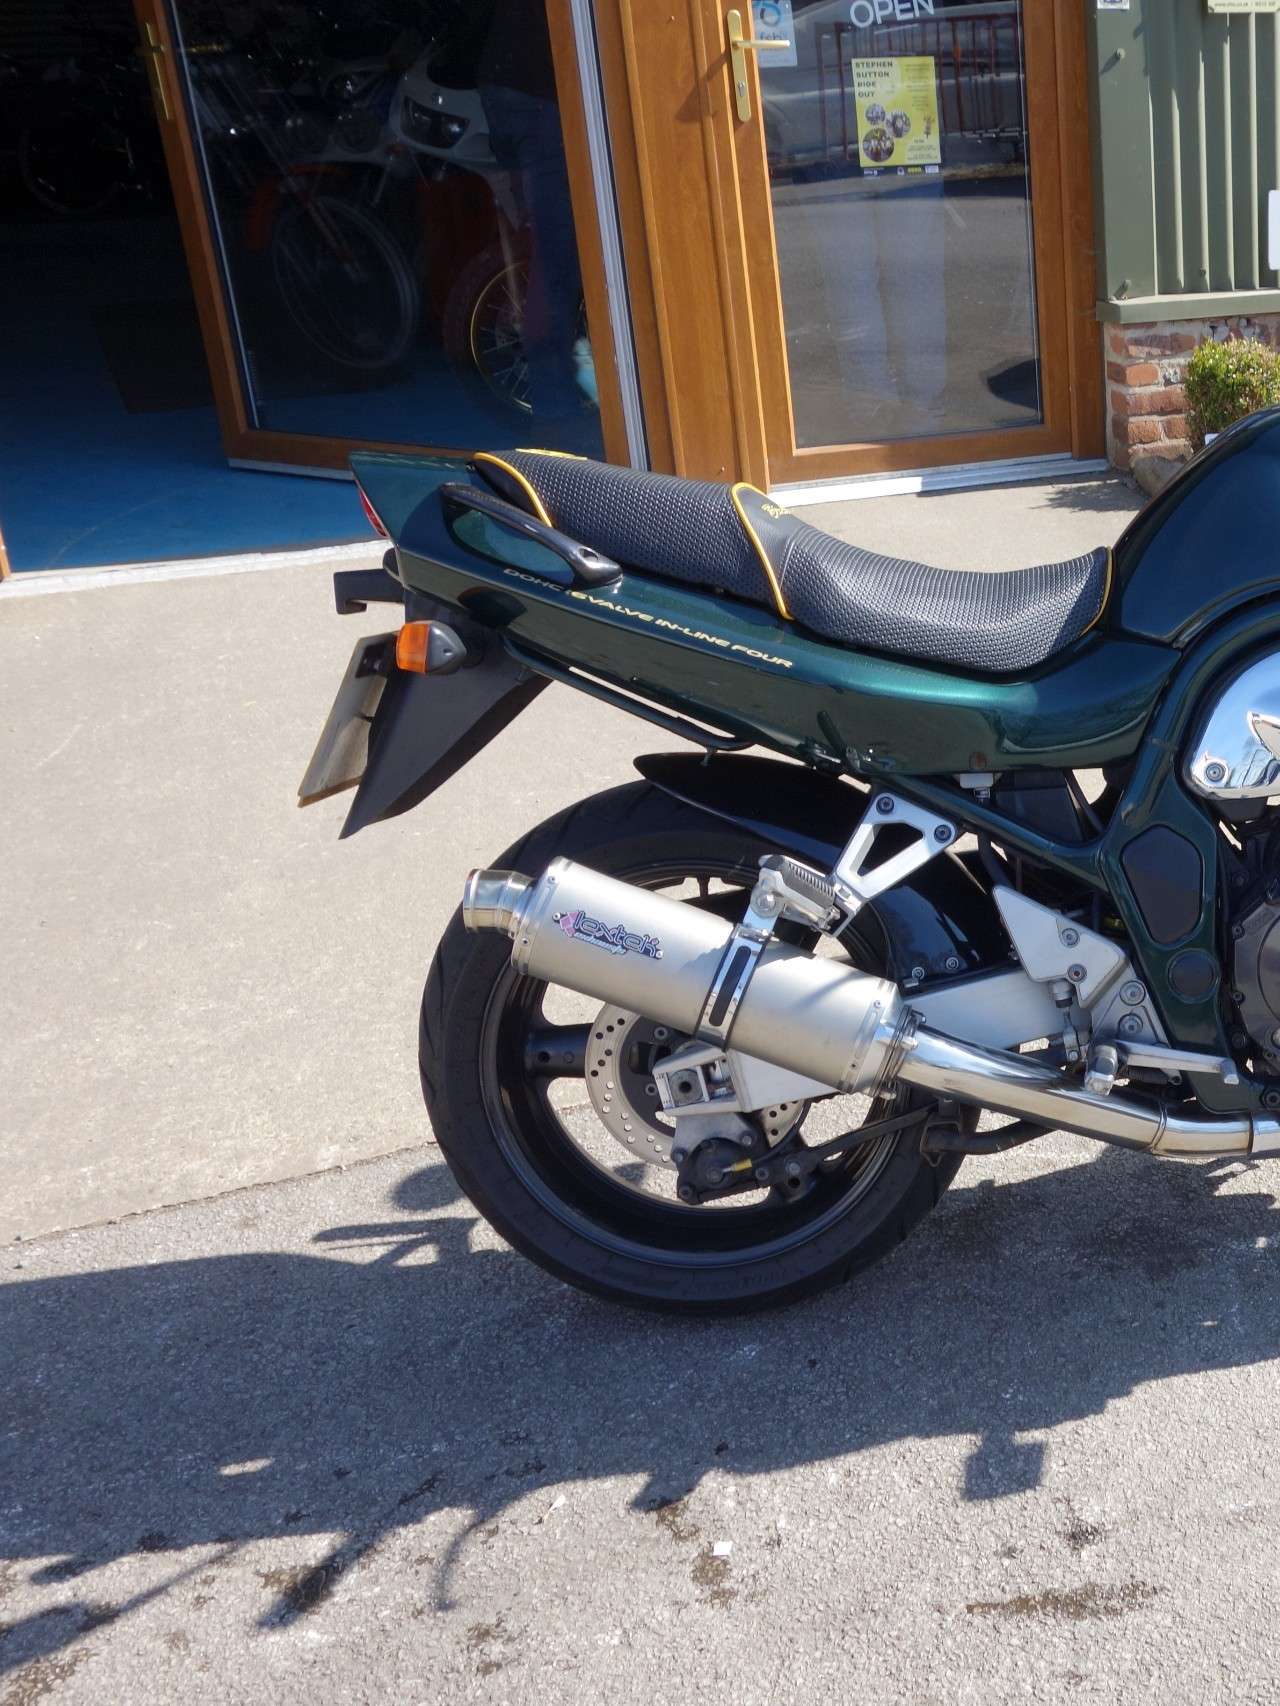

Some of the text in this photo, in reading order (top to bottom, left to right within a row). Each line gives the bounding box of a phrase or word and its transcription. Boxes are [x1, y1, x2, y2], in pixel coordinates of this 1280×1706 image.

[850, 0, 934, 28] OPEN
[503, 568, 565, 592] DOHC
[654, 618, 731, 648] IN-LINE
[731, 644, 793, 668] FOUR
[574, 910, 659, 957] lextek
